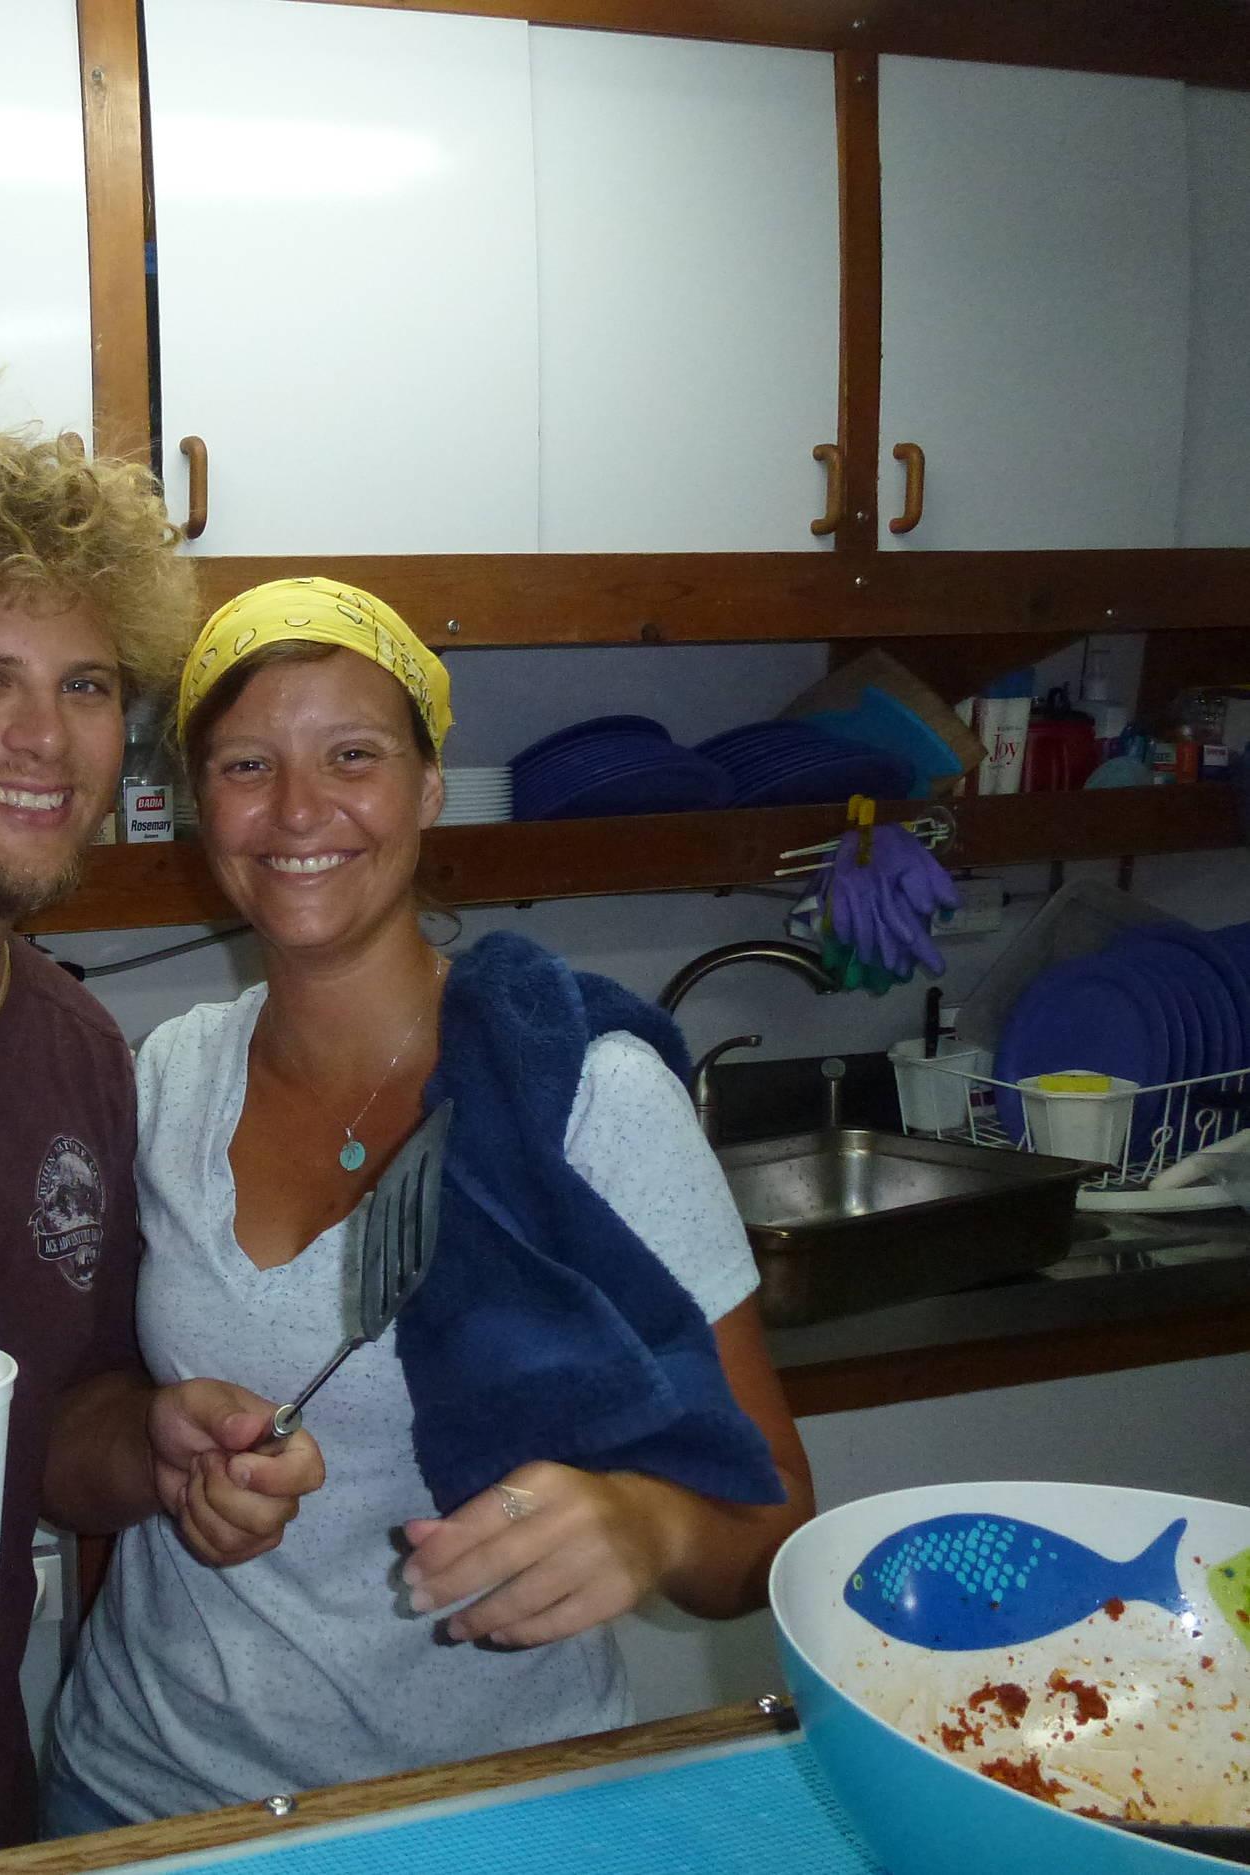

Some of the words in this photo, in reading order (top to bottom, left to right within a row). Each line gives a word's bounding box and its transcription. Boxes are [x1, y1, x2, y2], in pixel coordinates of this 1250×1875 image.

[989, 734, 1019, 766] Joy
[138, 798, 163, 808] BADIA
[131, 820, 171, 832] Rosemary
